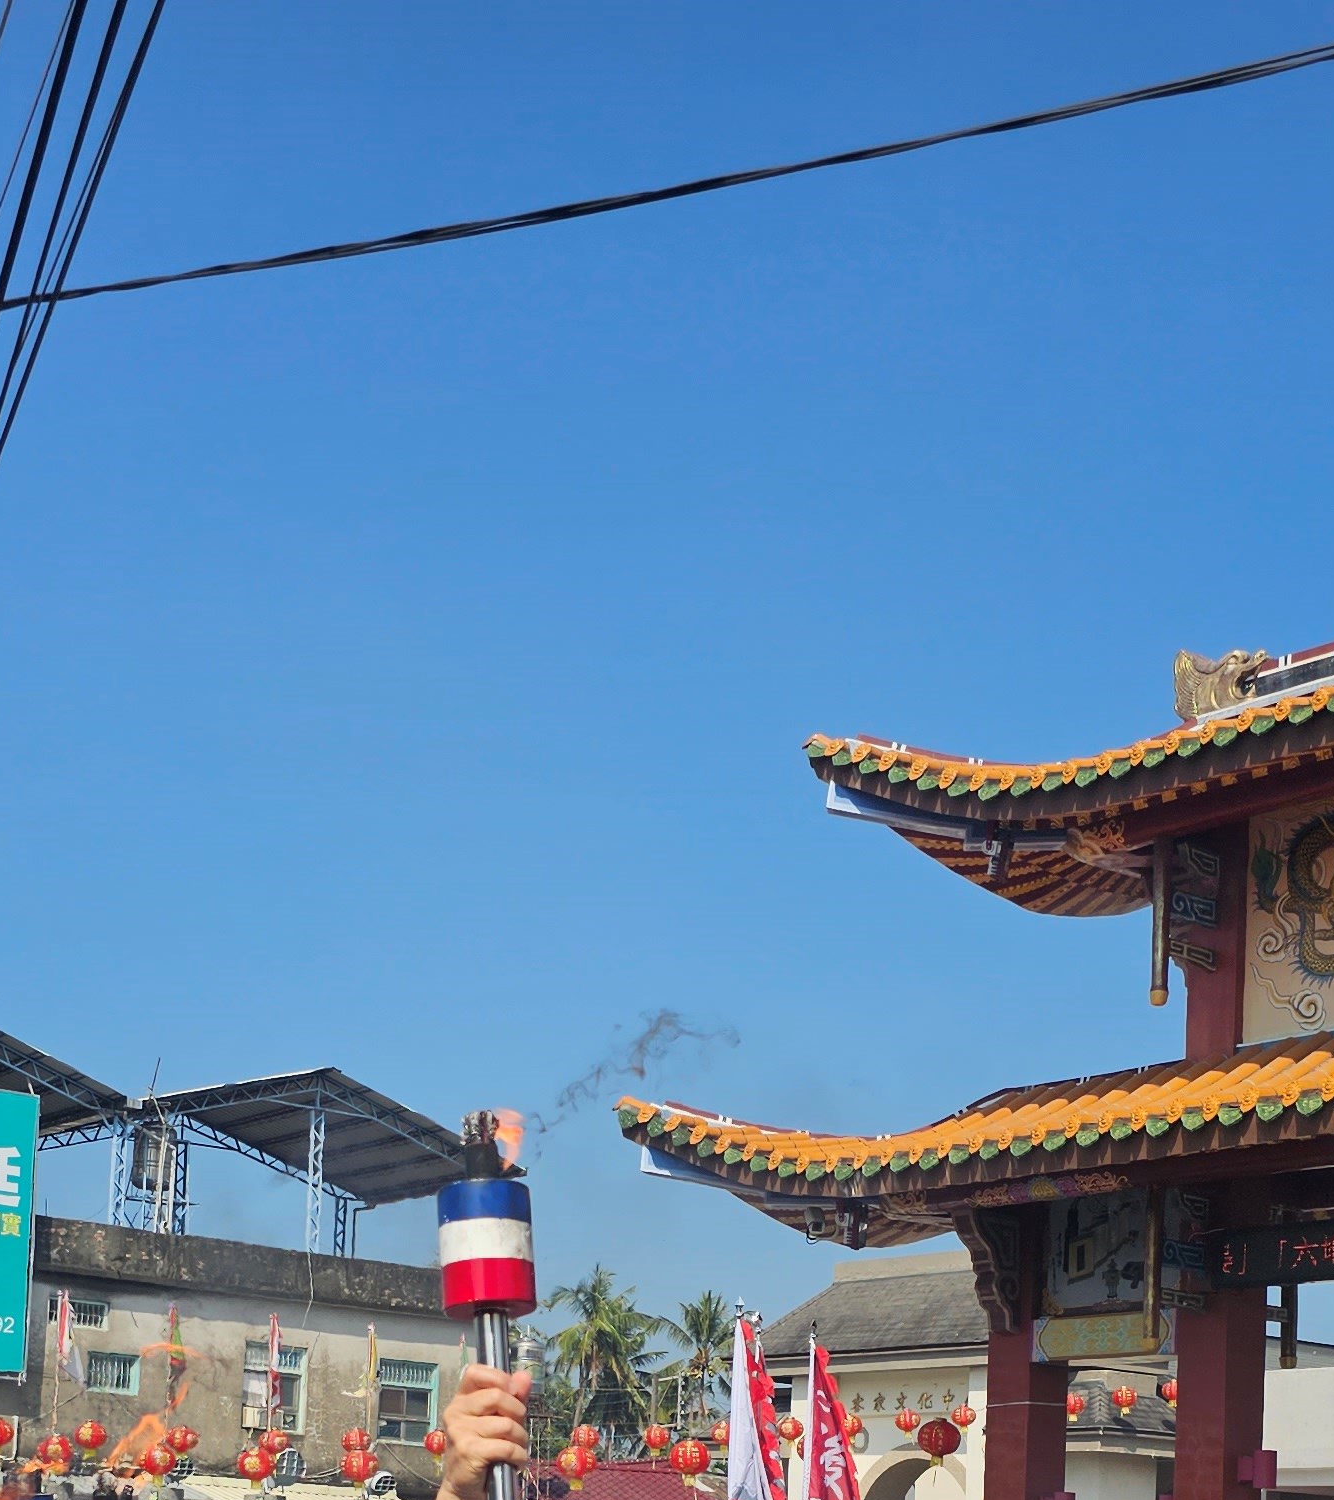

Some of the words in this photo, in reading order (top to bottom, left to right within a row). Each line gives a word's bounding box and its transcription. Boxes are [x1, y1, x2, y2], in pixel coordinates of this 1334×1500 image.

[850, 1388, 969, 1413] 客家文化中
